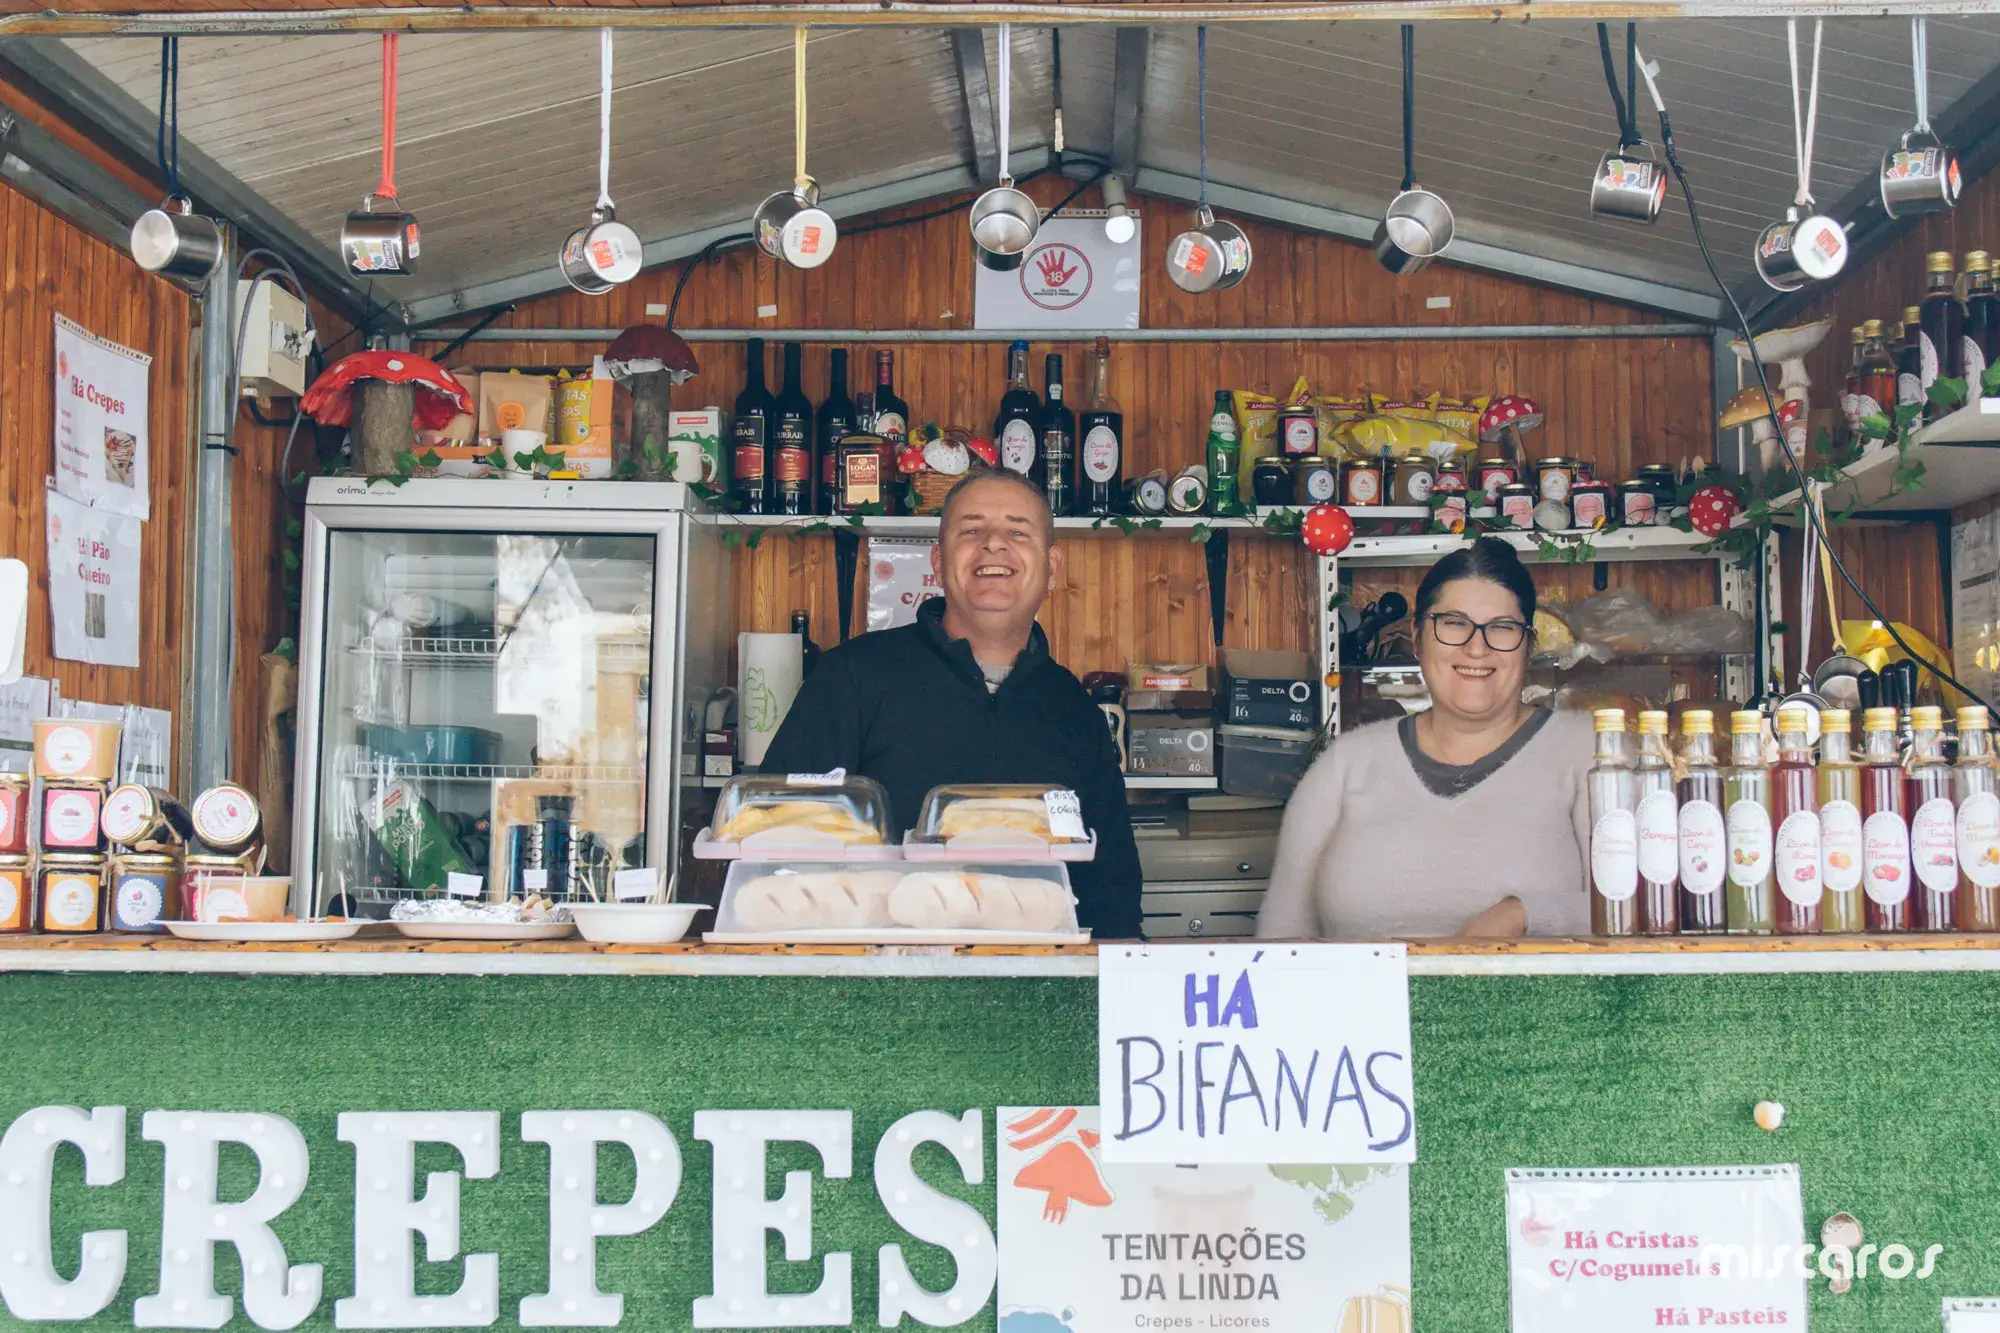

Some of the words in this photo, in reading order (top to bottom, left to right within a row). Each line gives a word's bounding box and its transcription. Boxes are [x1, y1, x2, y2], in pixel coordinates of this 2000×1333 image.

[72, 375, 84, 399] Há
[87, 383, 125, 415] Crepes
[337, 486, 366, 494] orima
[92, 541, 110, 560] Pão
[78, 563, 111, 585] Ceiro
[1235, 706, 1249, 718] 16
[1289, 714, 1302, 722] 40
[1189, 763, 1201, 772] 40
[1184, 950, 1258, 1029] HÁ
[0, 1105, 998, 1330] CREPES
[1102, 1227, 1306, 1268] TENTAÇÕES
[1564, 1231, 1599, 1249] Há
[1605, 1230, 1699, 1249] Cristas
[1120, 1274, 1166, 1301] DA
[1135, 1314, 1193, 1329] Crepes
[1209, 1314, 1270, 1328] Licores
[1655, 1307, 1690, 1326] Há
[1697, 1306, 1788, 1326] Pasteis
